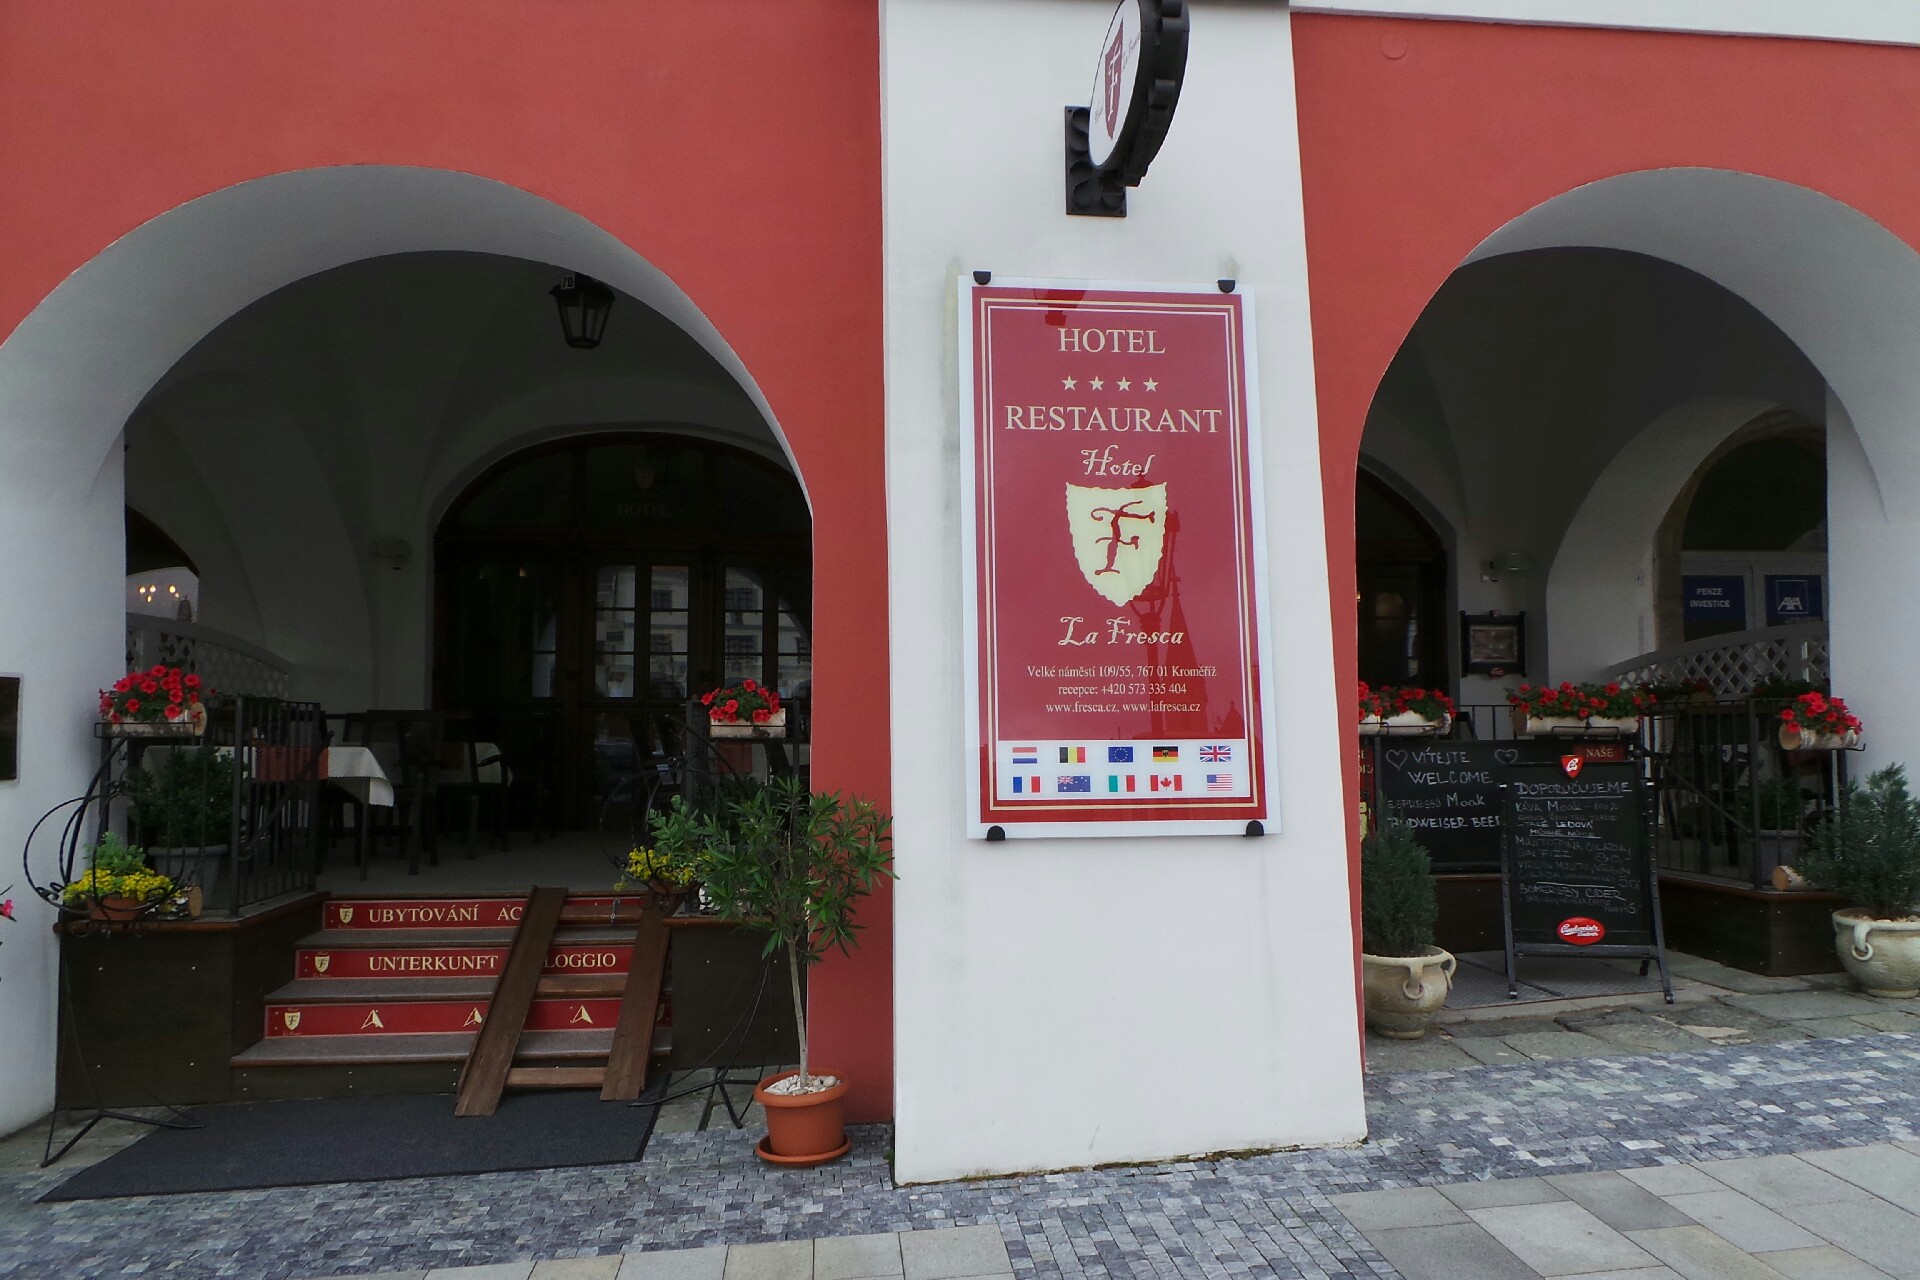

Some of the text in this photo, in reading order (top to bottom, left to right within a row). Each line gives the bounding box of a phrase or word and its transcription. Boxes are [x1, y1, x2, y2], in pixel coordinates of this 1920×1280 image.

[1058, 327, 1166, 354] HOTEL
[1004, 405, 1222, 433] RESTAURANT
[1081, 444, 1156, 476] Hotel
[1696, 587, 1723, 596] PENZE
[1689, 599, 1731, 608] INVESTICE
[1777, 596, 1804, 611] AXA
[1058, 616, 1184, 646] La Fresca
[1027, 664, 1217, 679] Velké náměstí 109/55, 767 01 Kroměříž
[1058, 683, 1187, 698] recepce: +420 573 335 404
[1045, 701, 1201, 714] www.fresca.cz, www.lafresca.cz
[1411, 746, 1471, 765] VÍTEJTE
[1585, 746, 1614, 758] NAŠE
[1408, 771, 1493, 786] WELCOME
[1514, 781, 1633, 796] DOPORUČUJEME
[1387, 792, 1486, 809] ESPRESSO Moak
[369, 904, 479, 923] UBYTOVÁNÍ
[368, 953, 499, 971] UNTERKUNFT
